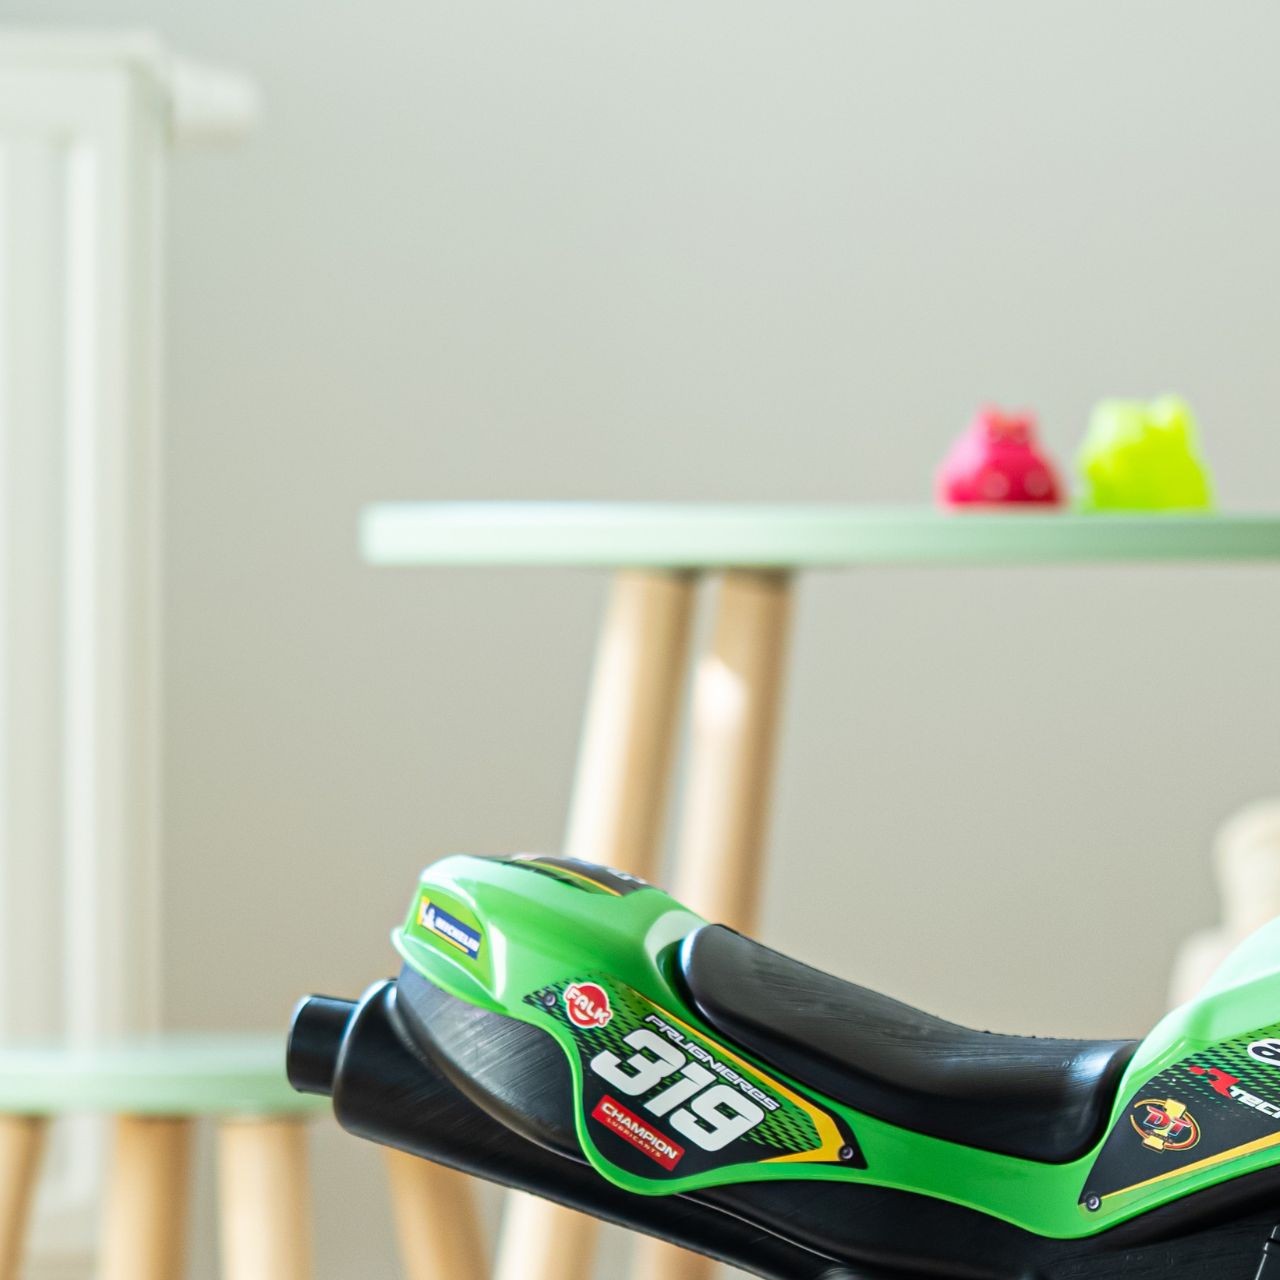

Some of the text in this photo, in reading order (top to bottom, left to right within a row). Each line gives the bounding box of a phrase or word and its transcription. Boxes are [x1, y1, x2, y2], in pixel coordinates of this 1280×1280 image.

[563, 984, 613, 1027] FALK
[590, 1028, 766, 1153] 319
[600, 1101, 679, 1161] CHAMPION
[606, 1116, 663, 1159] LUBRICANTS
